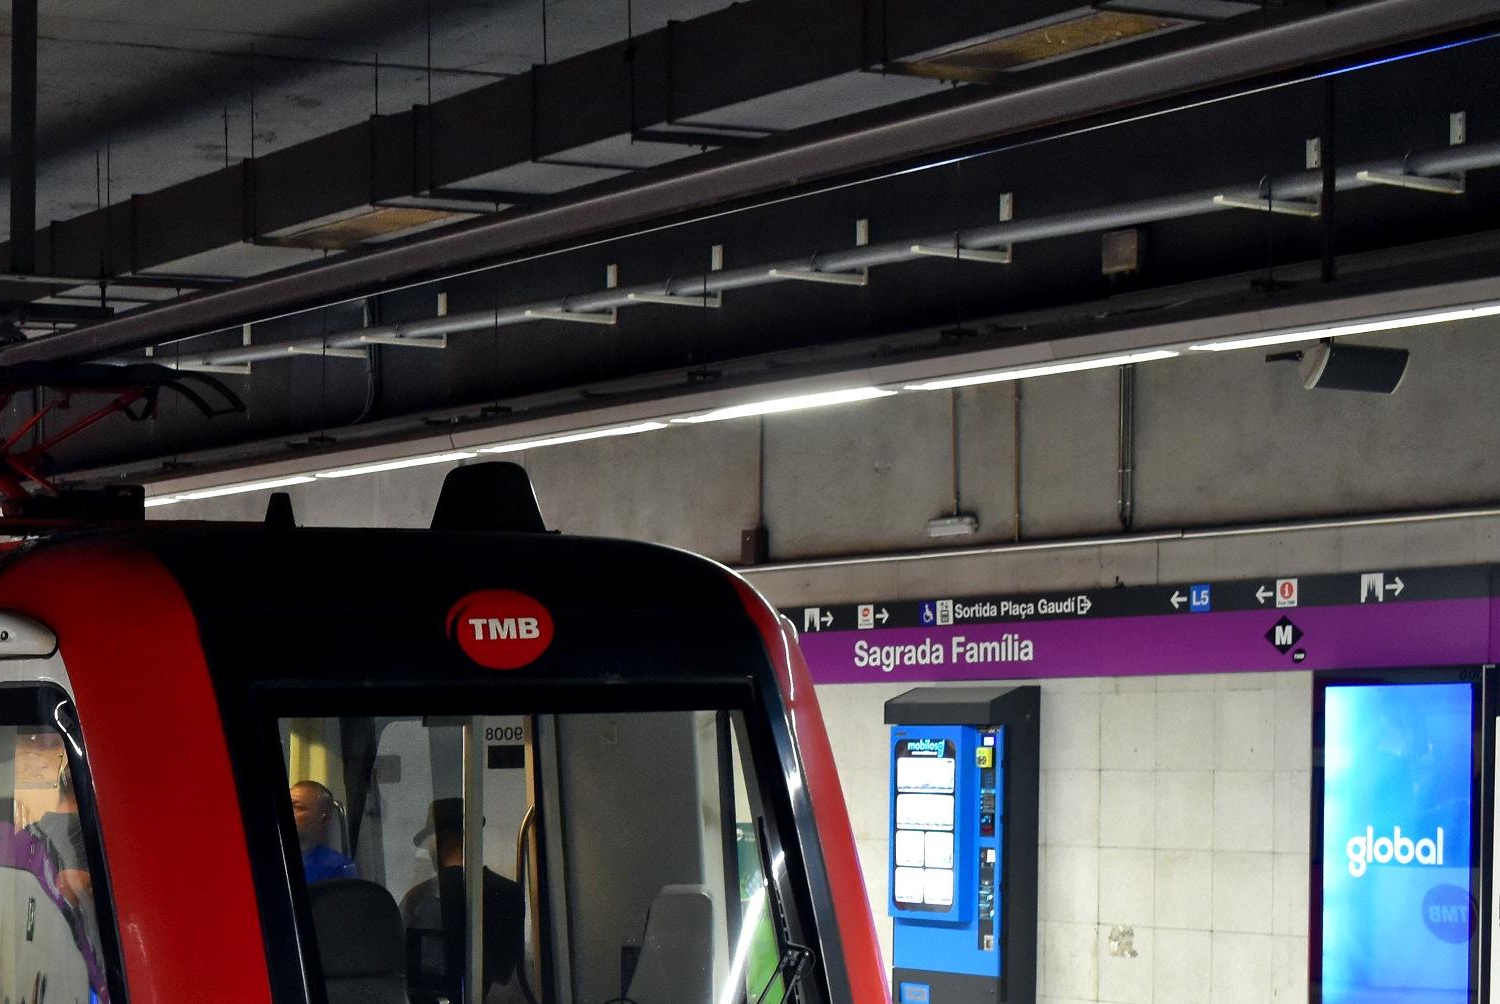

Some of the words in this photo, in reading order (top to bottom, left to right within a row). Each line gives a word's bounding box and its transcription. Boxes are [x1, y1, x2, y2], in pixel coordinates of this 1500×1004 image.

[955, 602, 998, 619] Sortida
[1000, 600, 1034, 619] Plaça
[1037, 597, 1076, 614] Gaudí
[1192, 589, 1209, 606] L5
[468, 617, 540, 640] TMB
[1274, 625, 1293, 645] M
[854, 637, 944, 672] Sagrada
[951, 633, 1034, 664] Família
[1346, 825, 1444, 878] global
